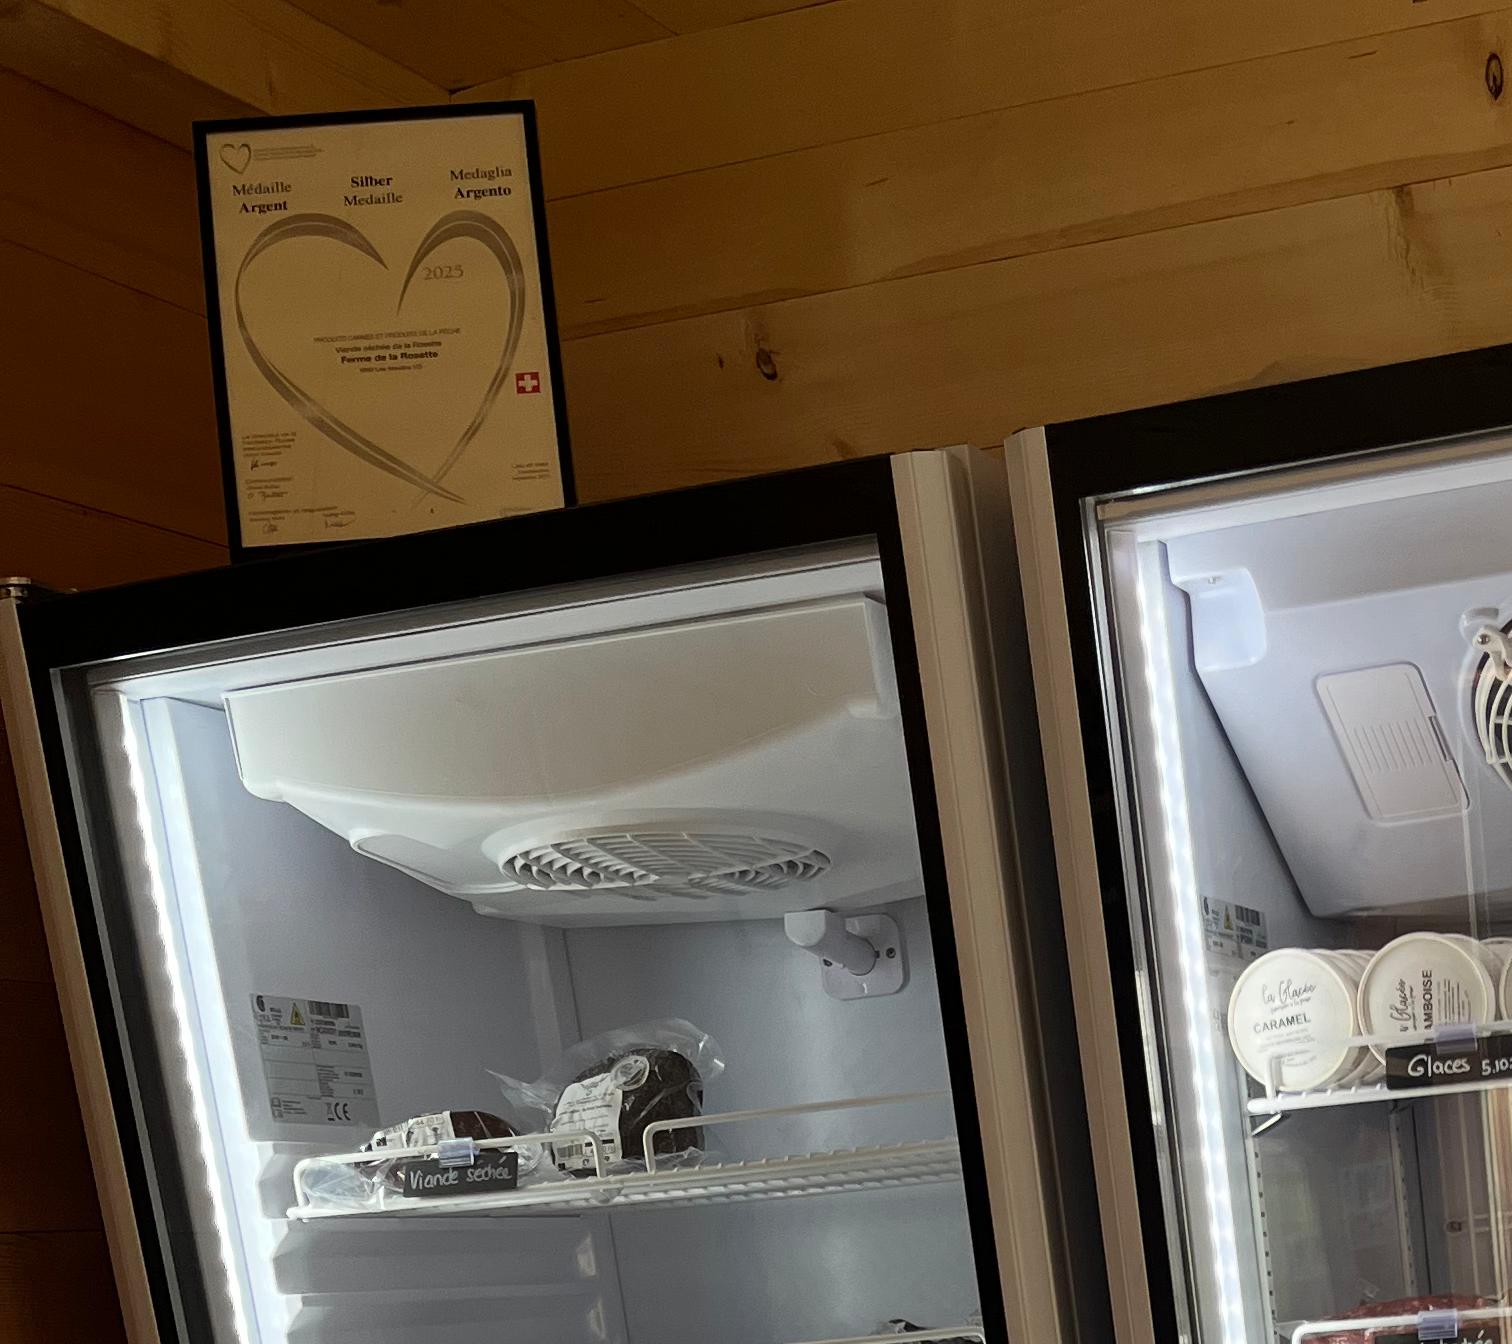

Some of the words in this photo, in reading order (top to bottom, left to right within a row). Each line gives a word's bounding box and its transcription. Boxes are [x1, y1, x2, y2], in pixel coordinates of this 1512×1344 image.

[350, 175, 393, 188] Silber
[450, 166, 512, 182] Medaglia
[232, 181, 292, 196] Médaille
[454, 186, 512, 200] Argento
[343, 192, 403, 207] Medaille
[239, 200, 288, 215] Argent
[423, 264, 464, 281] 2025
[375, 354, 386, 362] de
[1422, 970, 1434, 1031] AMBOISE
[1253, 1013, 1312, 1033] CARAMEL
[1407, 1054, 1470, 1077] Glaces
[410, 1169, 459, 1190] Viande
